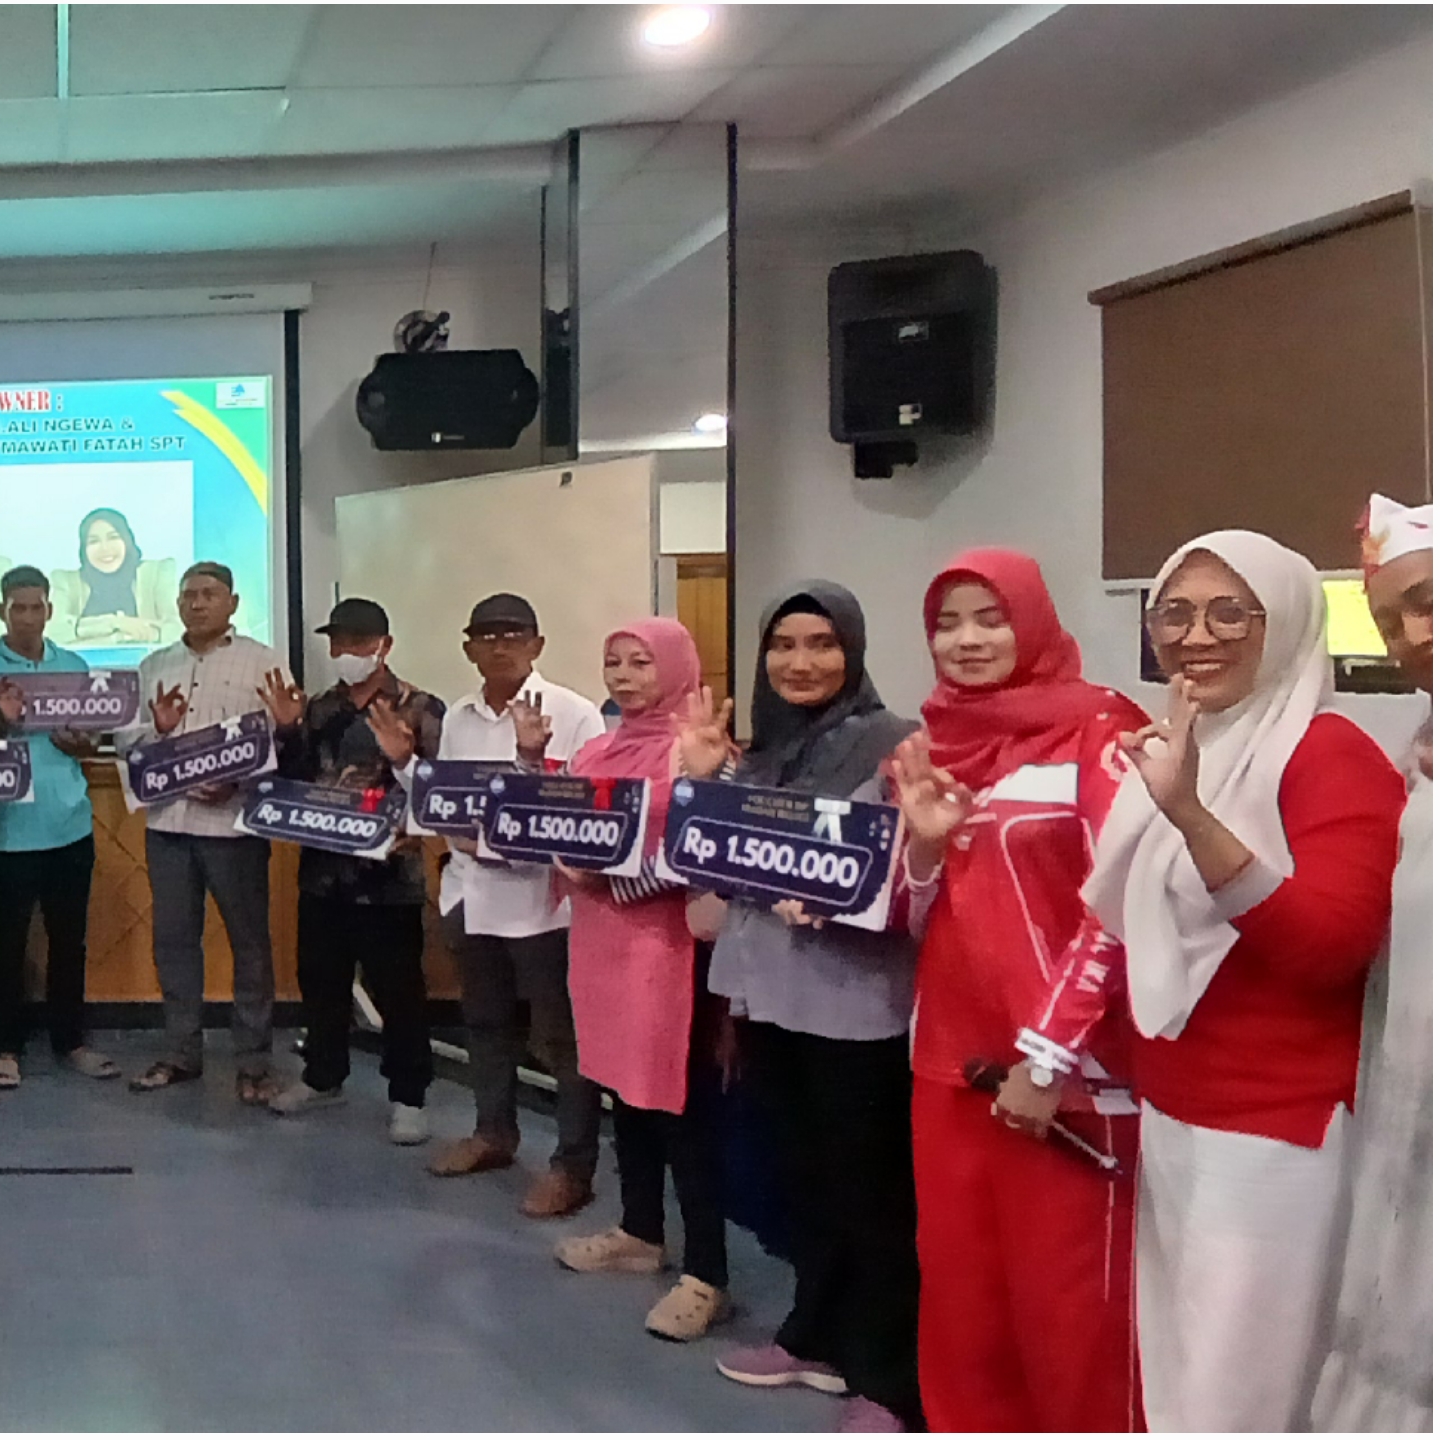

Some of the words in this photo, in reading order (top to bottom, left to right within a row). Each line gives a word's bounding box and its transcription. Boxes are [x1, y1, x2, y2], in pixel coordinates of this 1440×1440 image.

[44, 418, 113, 432] NGEWA
[121, 417, 134, 430] &
[83, 437, 143, 451] FATAH
[150, 436, 185, 450] SPT
[33, 698, 122, 716] 1.500.000
[145, 770, 168, 791] Rp
[173, 741, 256, 781] 1.500.000
[257, 803, 283, 824] Rp
[288, 808, 378, 838] 1.500.000
[429, 794, 457, 820] Rp
[497, 812, 522, 841] Rp
[527, 814, 620, 847] 1.500.000
[682, 826, 717, 865] Rp
[726, 834, 860, 889] 1.500.000
